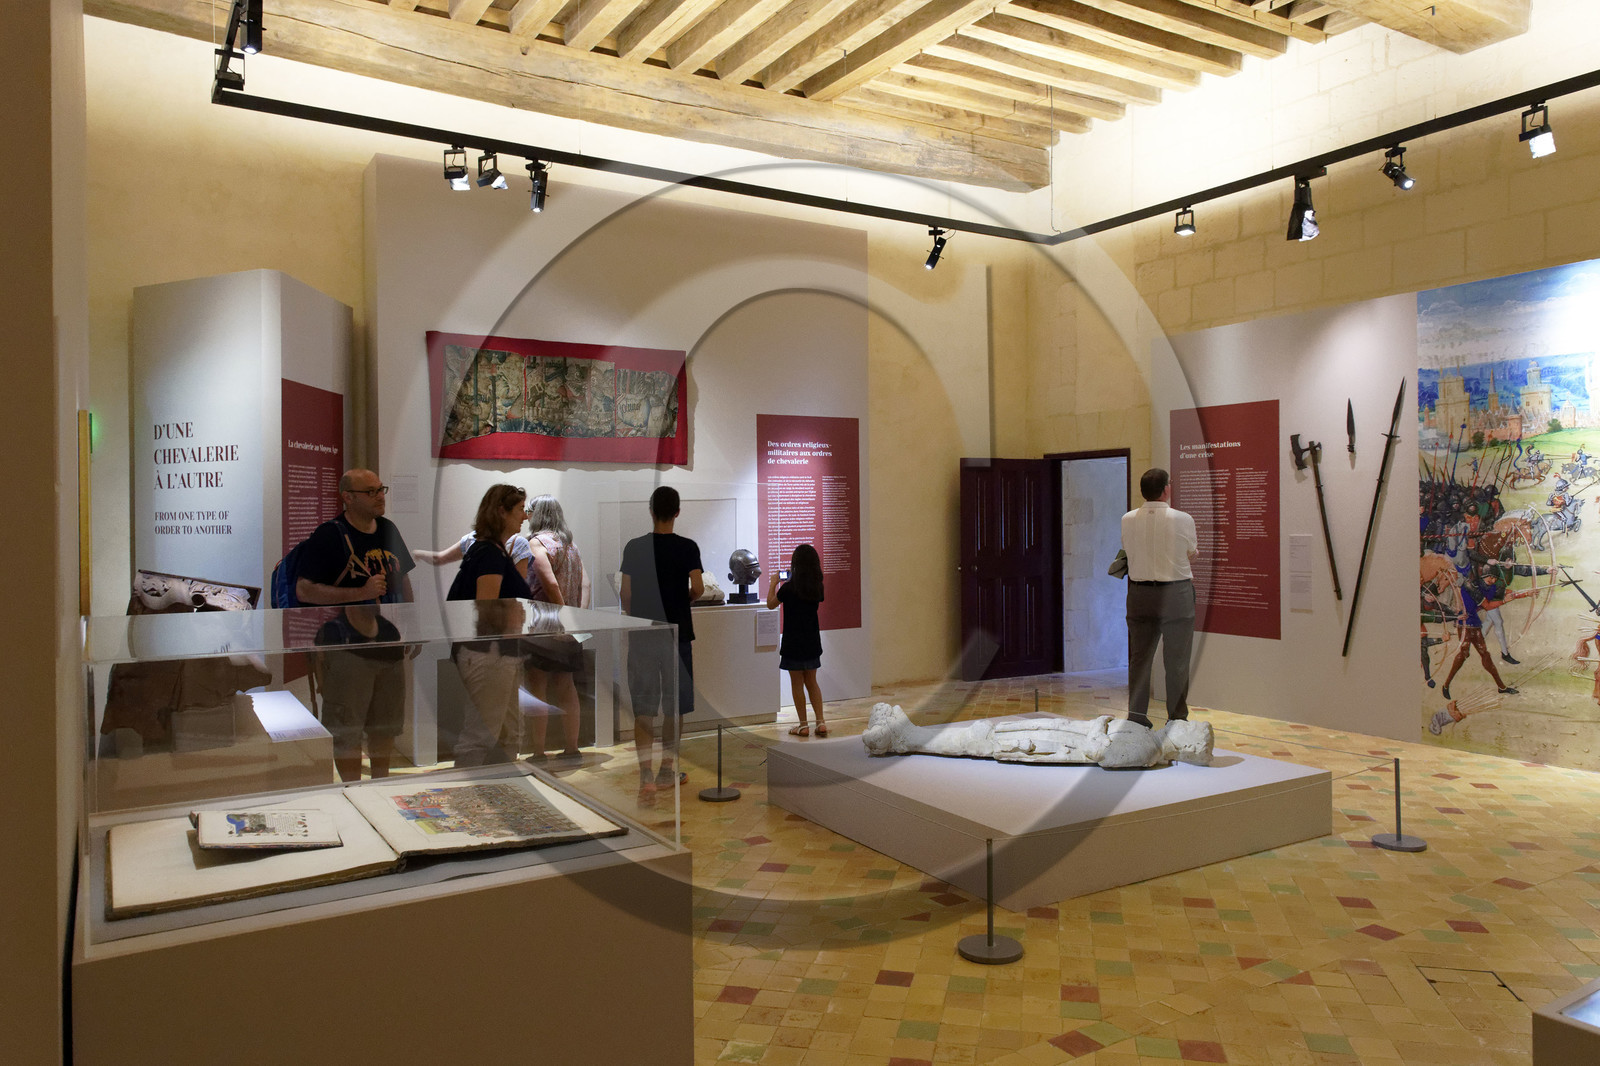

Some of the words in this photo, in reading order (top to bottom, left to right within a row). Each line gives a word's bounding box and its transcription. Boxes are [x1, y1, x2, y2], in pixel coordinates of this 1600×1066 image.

[802, 441, 832, 450] religieux-
[1191, 441, 1241, 450] manifestations
[154, 445, 239, 465] CHEVALERIE
[154, 470, 163, 490] À
[155, 511, 177, 521] FROM
[178, 511, 195, 521] ONE
[196, 511, 217, 521] TYPE
[218, 510, 230, 520] OF
[154, 525, 181, 535] ORDER
[182, 525, 193, 535] TO
[194, 524, 232, 535] ANOTHER
